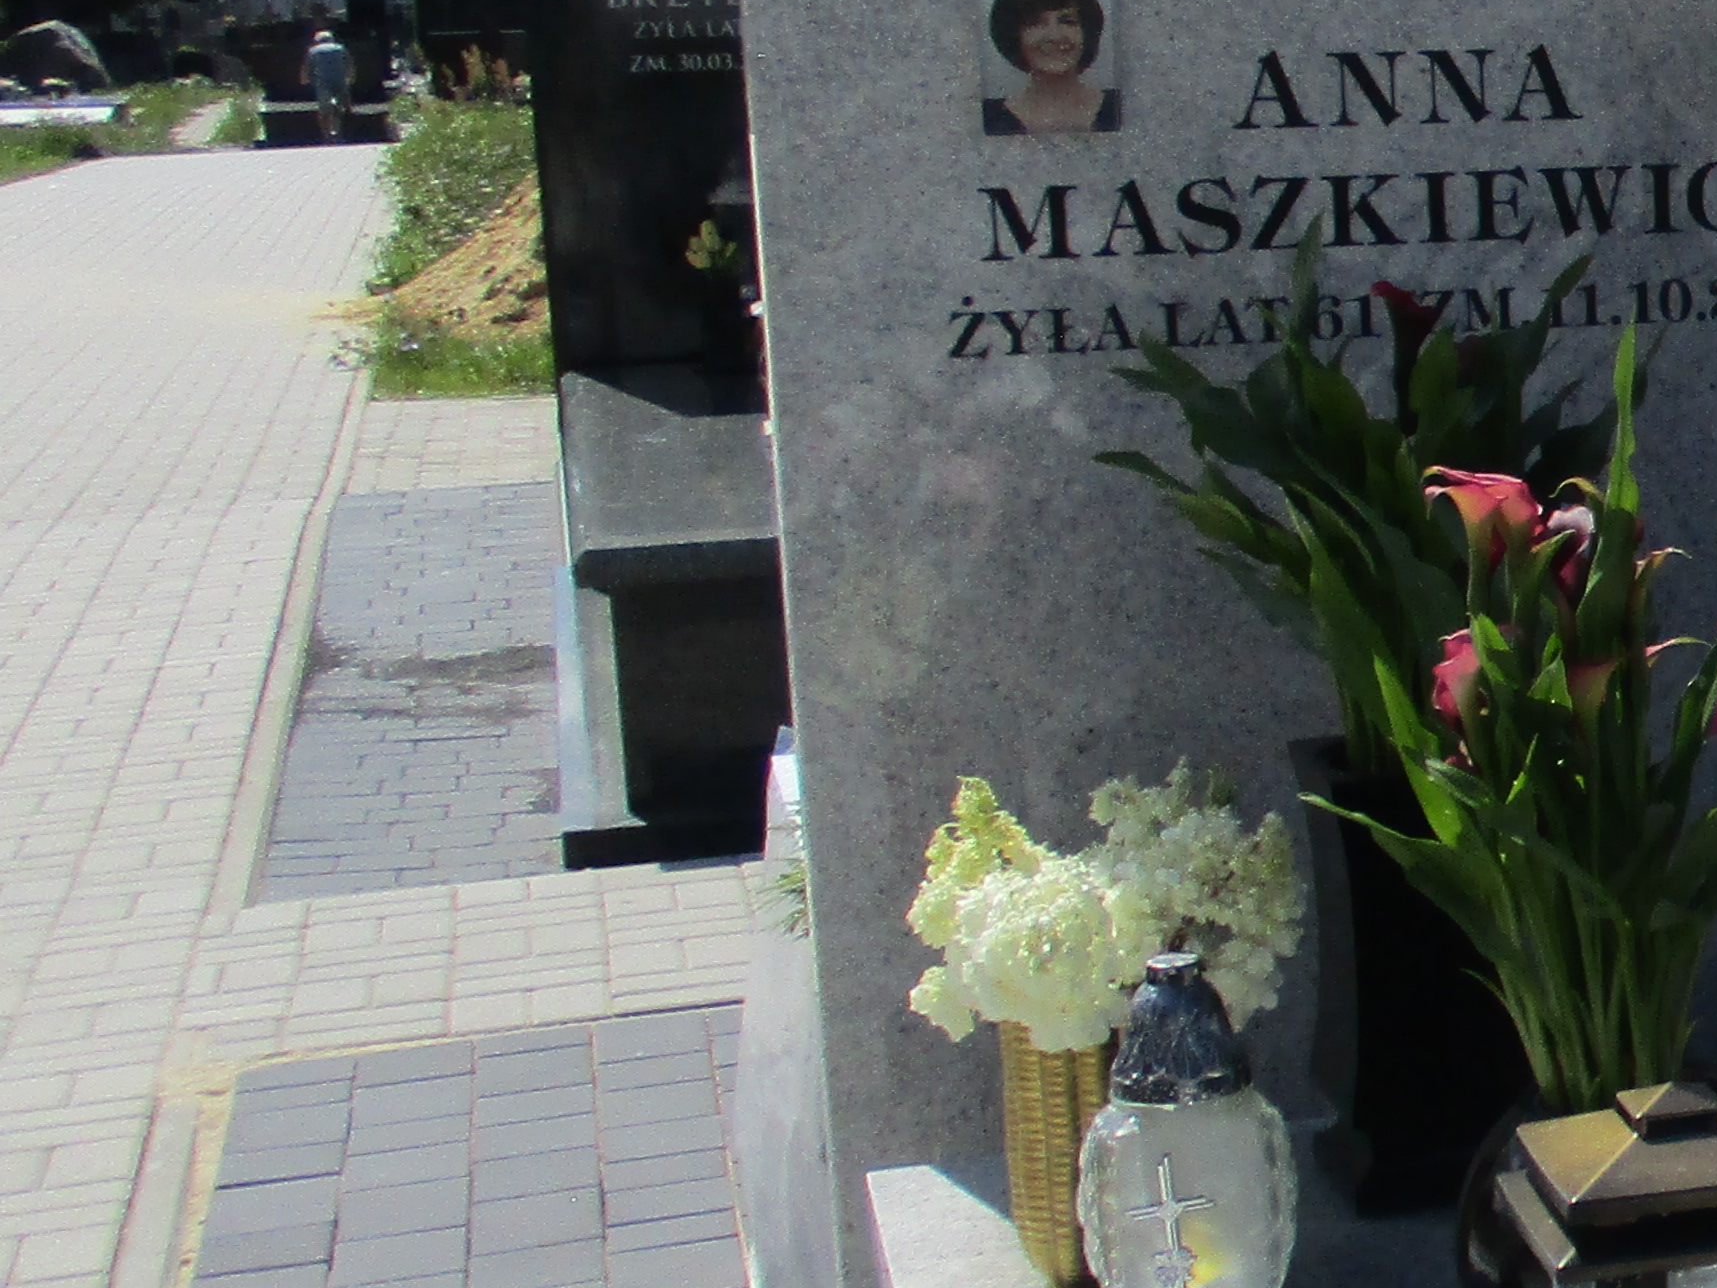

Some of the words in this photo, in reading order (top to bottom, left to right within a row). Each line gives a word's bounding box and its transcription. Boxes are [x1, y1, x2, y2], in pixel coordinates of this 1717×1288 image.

[1232, 43, 1583, 132] ANNA
[949, 295, 1139, 360] ŻYŁA
[1158, 296, 1290, 348] LAT
